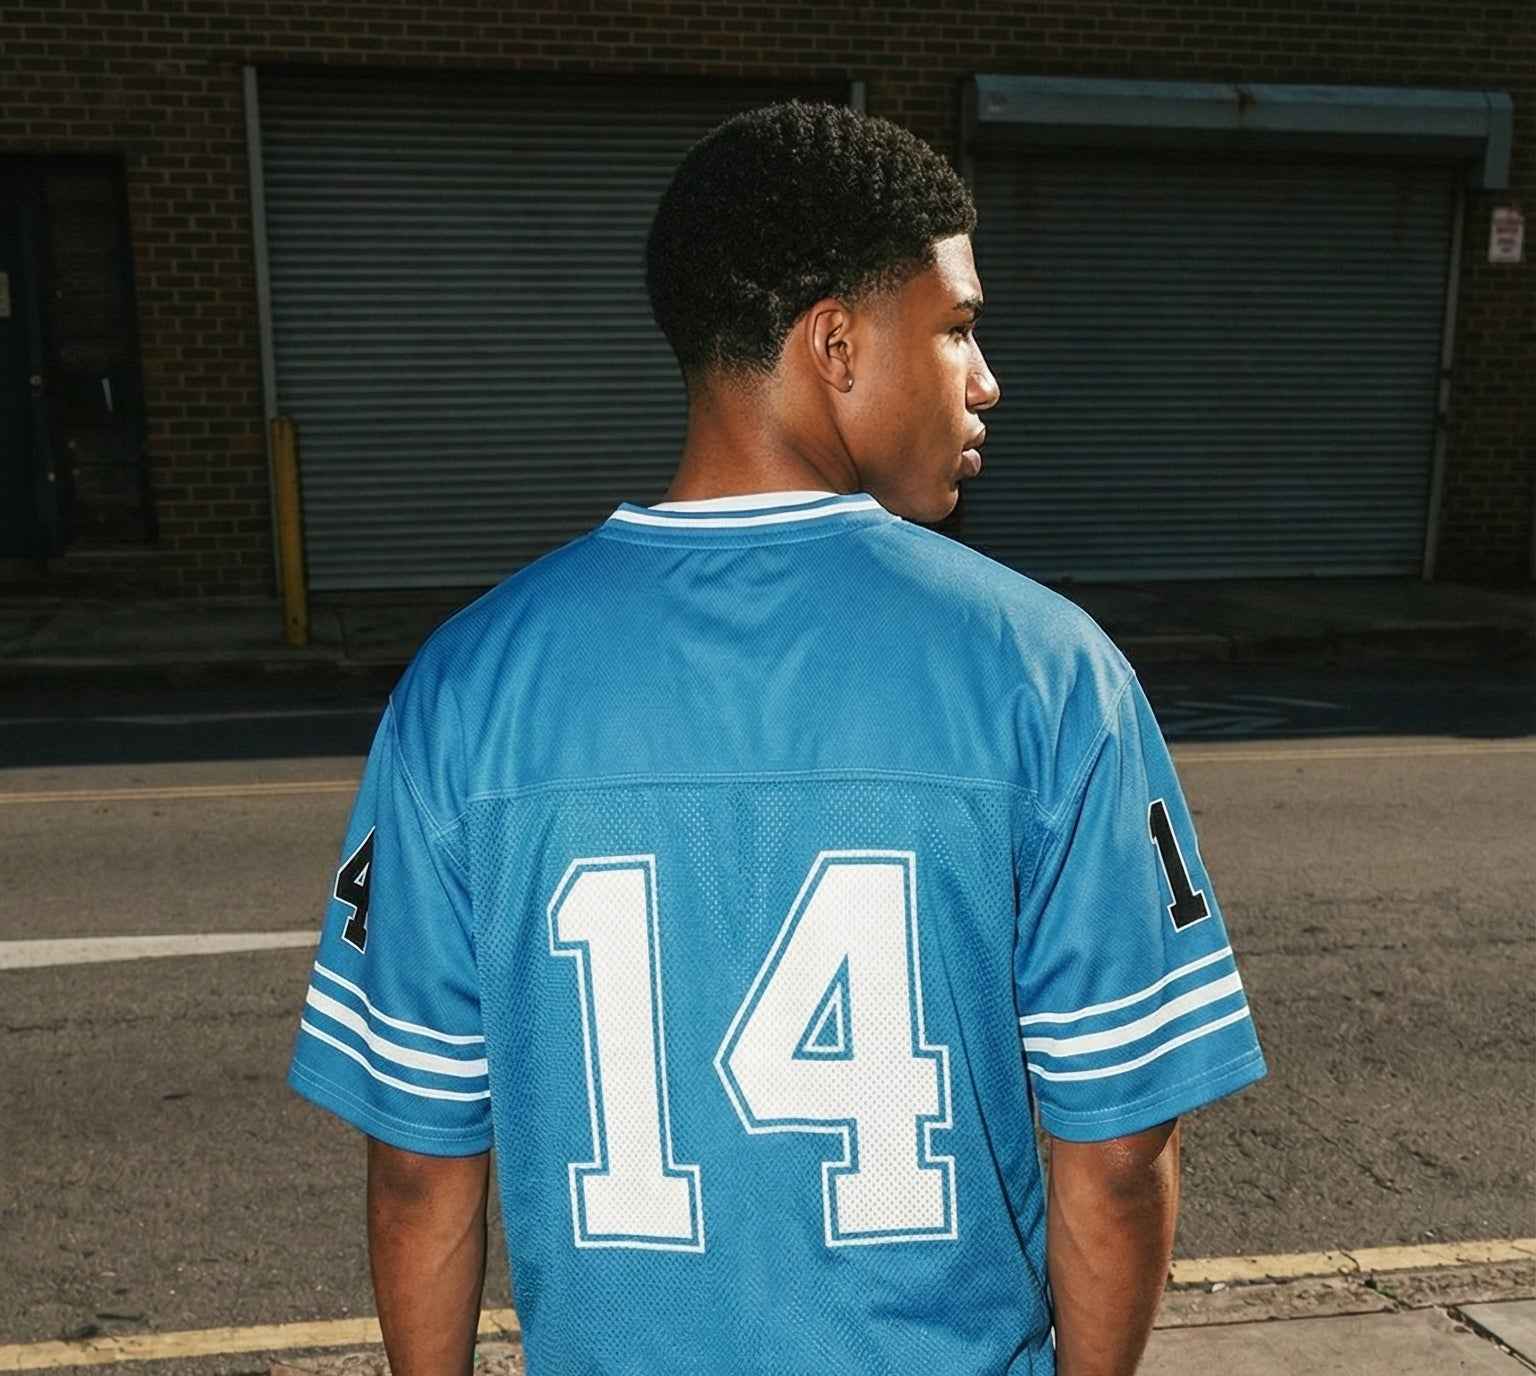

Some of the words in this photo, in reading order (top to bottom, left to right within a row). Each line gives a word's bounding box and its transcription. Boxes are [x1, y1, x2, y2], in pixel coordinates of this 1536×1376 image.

[334, 825, 375, 954] 4
[1148, 798, 1211, 932] 1
[547, 850, 958, 1253] 14
